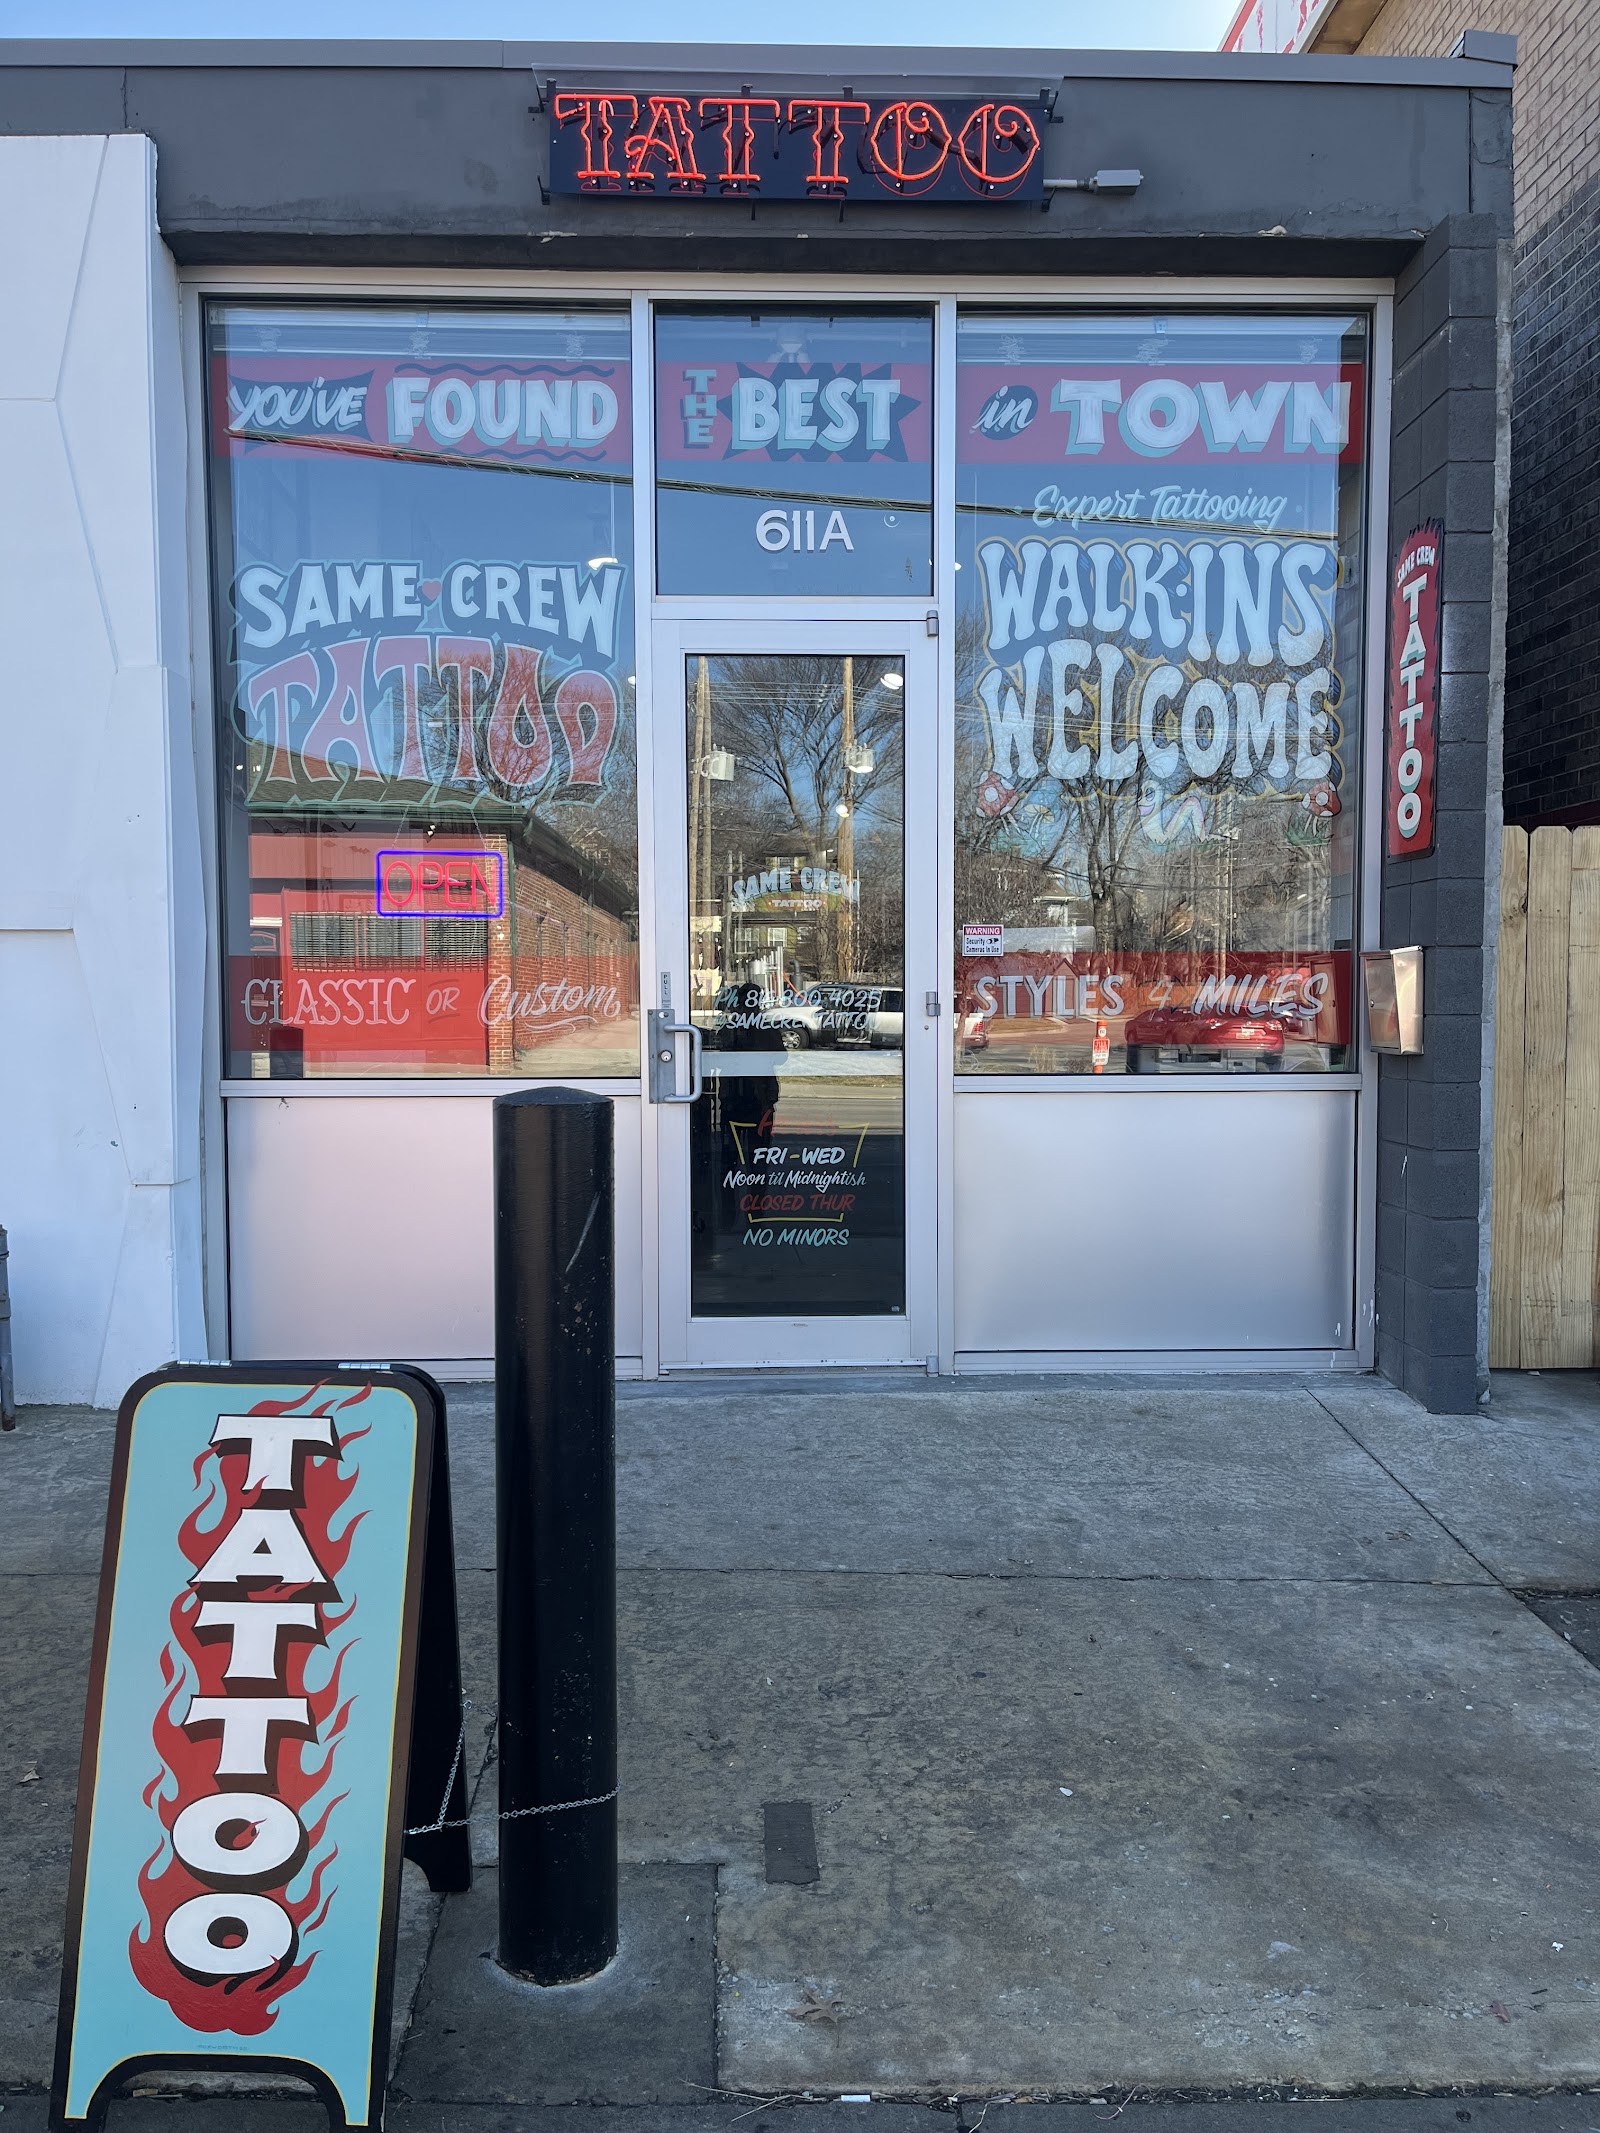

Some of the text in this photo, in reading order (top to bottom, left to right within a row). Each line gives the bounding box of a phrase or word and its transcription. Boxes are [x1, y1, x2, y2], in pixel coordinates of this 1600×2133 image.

[554, 92, 1041, 184] TATTOO
[227, 376, 619, 449] YOU'VE FOUND
[681, 368, 901, 451] THE BEST
[971, 378, 1352, 458] in TOWN
[755, 509, 855, 552] 611A
[1032, 484, 1288, 535] Expert Tattooing
[1397, 545, 1436, 589] SAME CREW
[237, 563, 624, 658] SAME CREW
[247, 634, 618, 788] TATTOO
[978, 638, 1333, 780] WELCOME
[1397, 572, 1428, 839] TATTOO
[383, 860, 497, 908] OPEN
[732, 865, 861, 907] SAME CREW
[771, 898, 823, 908] TATTOO
[965, 927, 1001, 935] WARNING
[966, 937, 986, 946] Security
[966, 945, 985, 953] Cameras
[241, 975, 621, 1029] CLASSIC OR Custom
[713, 986, 740, 1010] Ph
[829, 987, 883, 1010] 4025
[975, 973, 1329, 1021] STYLES 4 MILES
[722, 1170, 766, 1189] Noon
[783, 1169, 867, 1194] Midnightish
[739, 1193, 856, 1212] CLOSED THUR
[742, 1227, 850, 1247] NO MINORS
[163, 1413, 344, 1987] TATTOO
